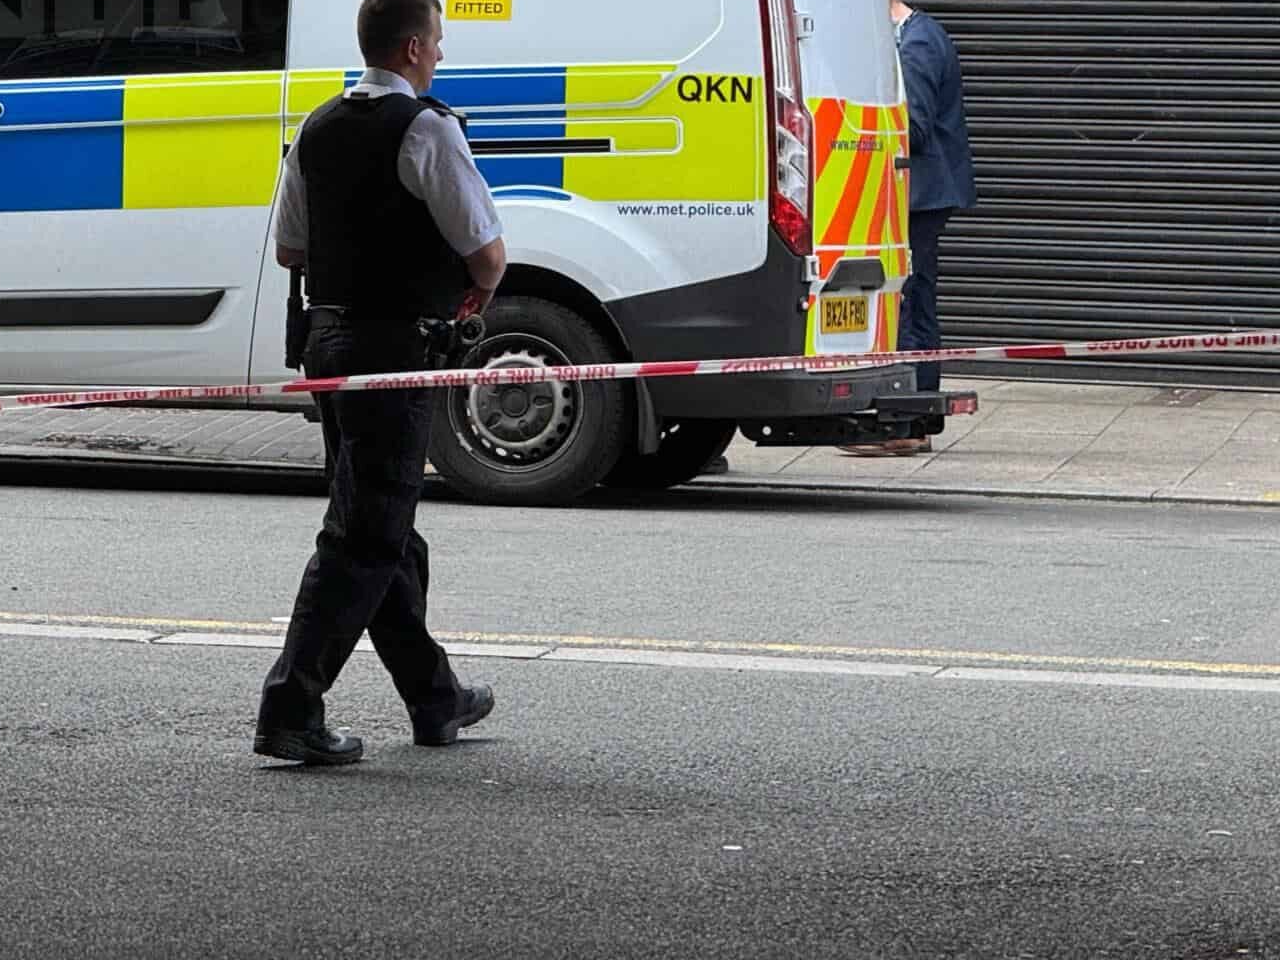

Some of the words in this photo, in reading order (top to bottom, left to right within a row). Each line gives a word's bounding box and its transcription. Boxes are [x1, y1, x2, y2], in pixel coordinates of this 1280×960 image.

[455, 2, 503, 14] FITTED
[677, 74, 754, 104] QKN
[617, 202, 755, 218] www.met.police.uk
